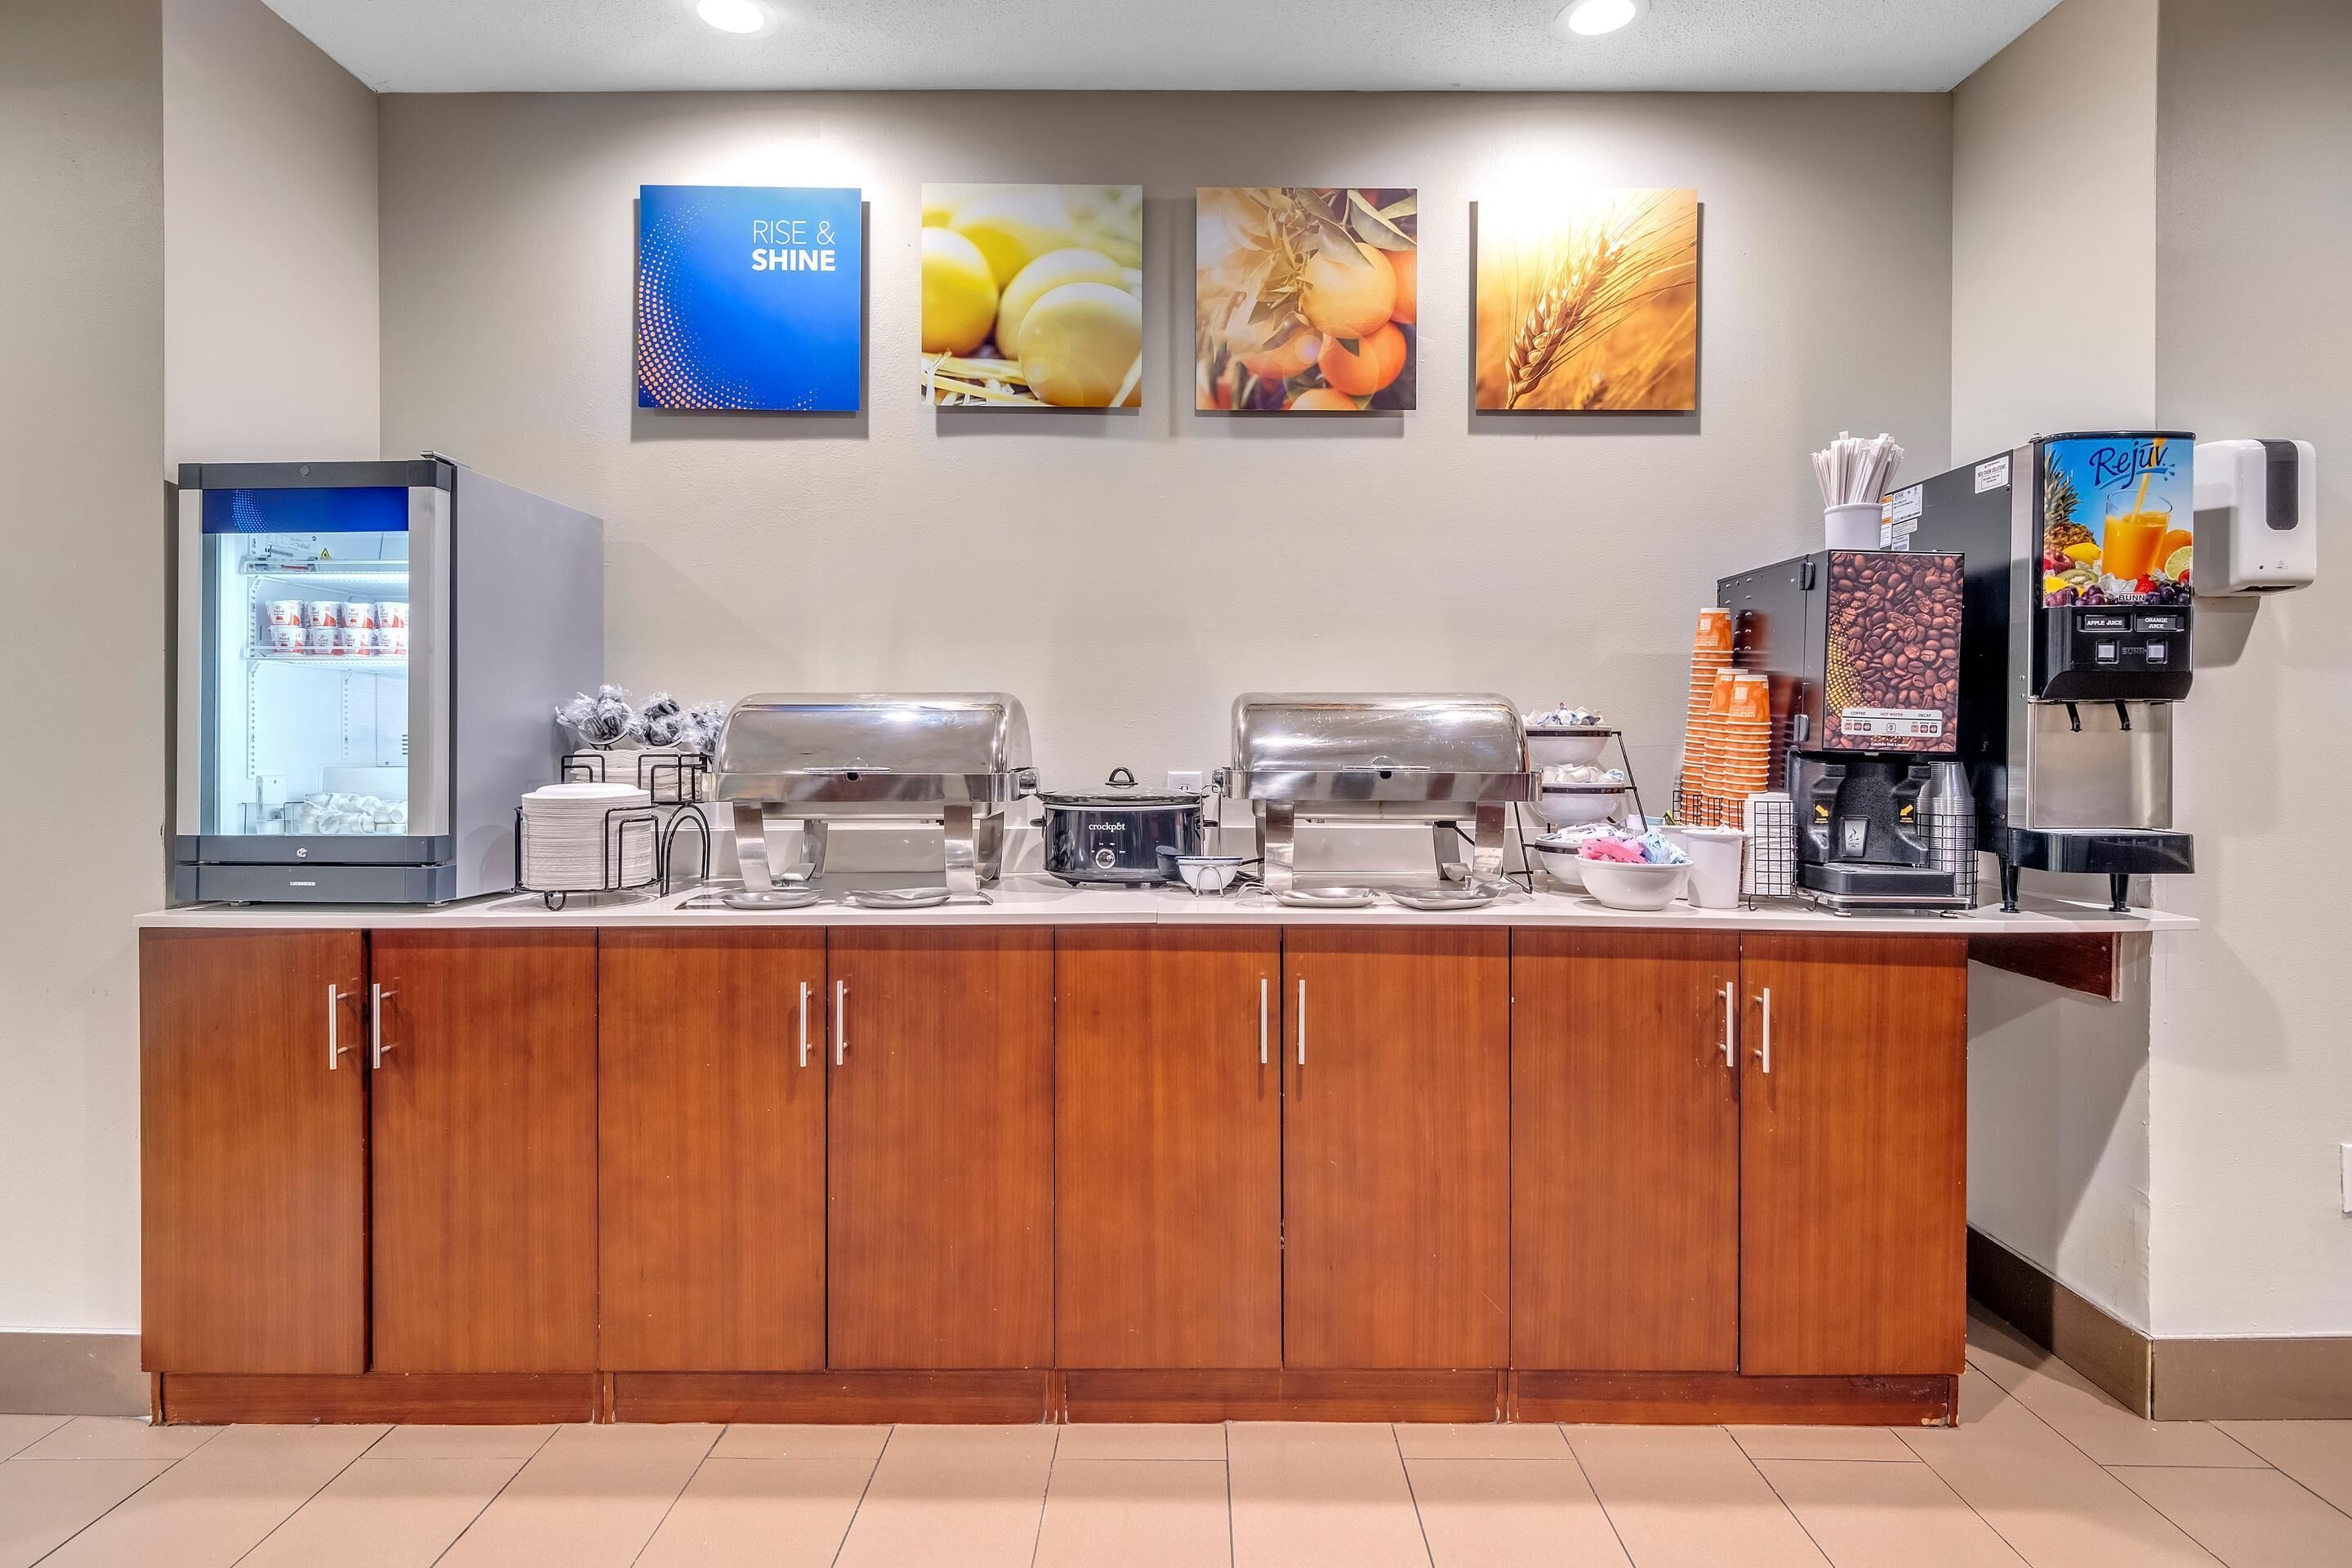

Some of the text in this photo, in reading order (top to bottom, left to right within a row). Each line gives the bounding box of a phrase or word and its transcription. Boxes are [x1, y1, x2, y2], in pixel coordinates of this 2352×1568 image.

[753, 220, 836, 245] RISE &
[751, 248, 836, 271] SHINE
[1089, 822, 1126, 833] crockpot
